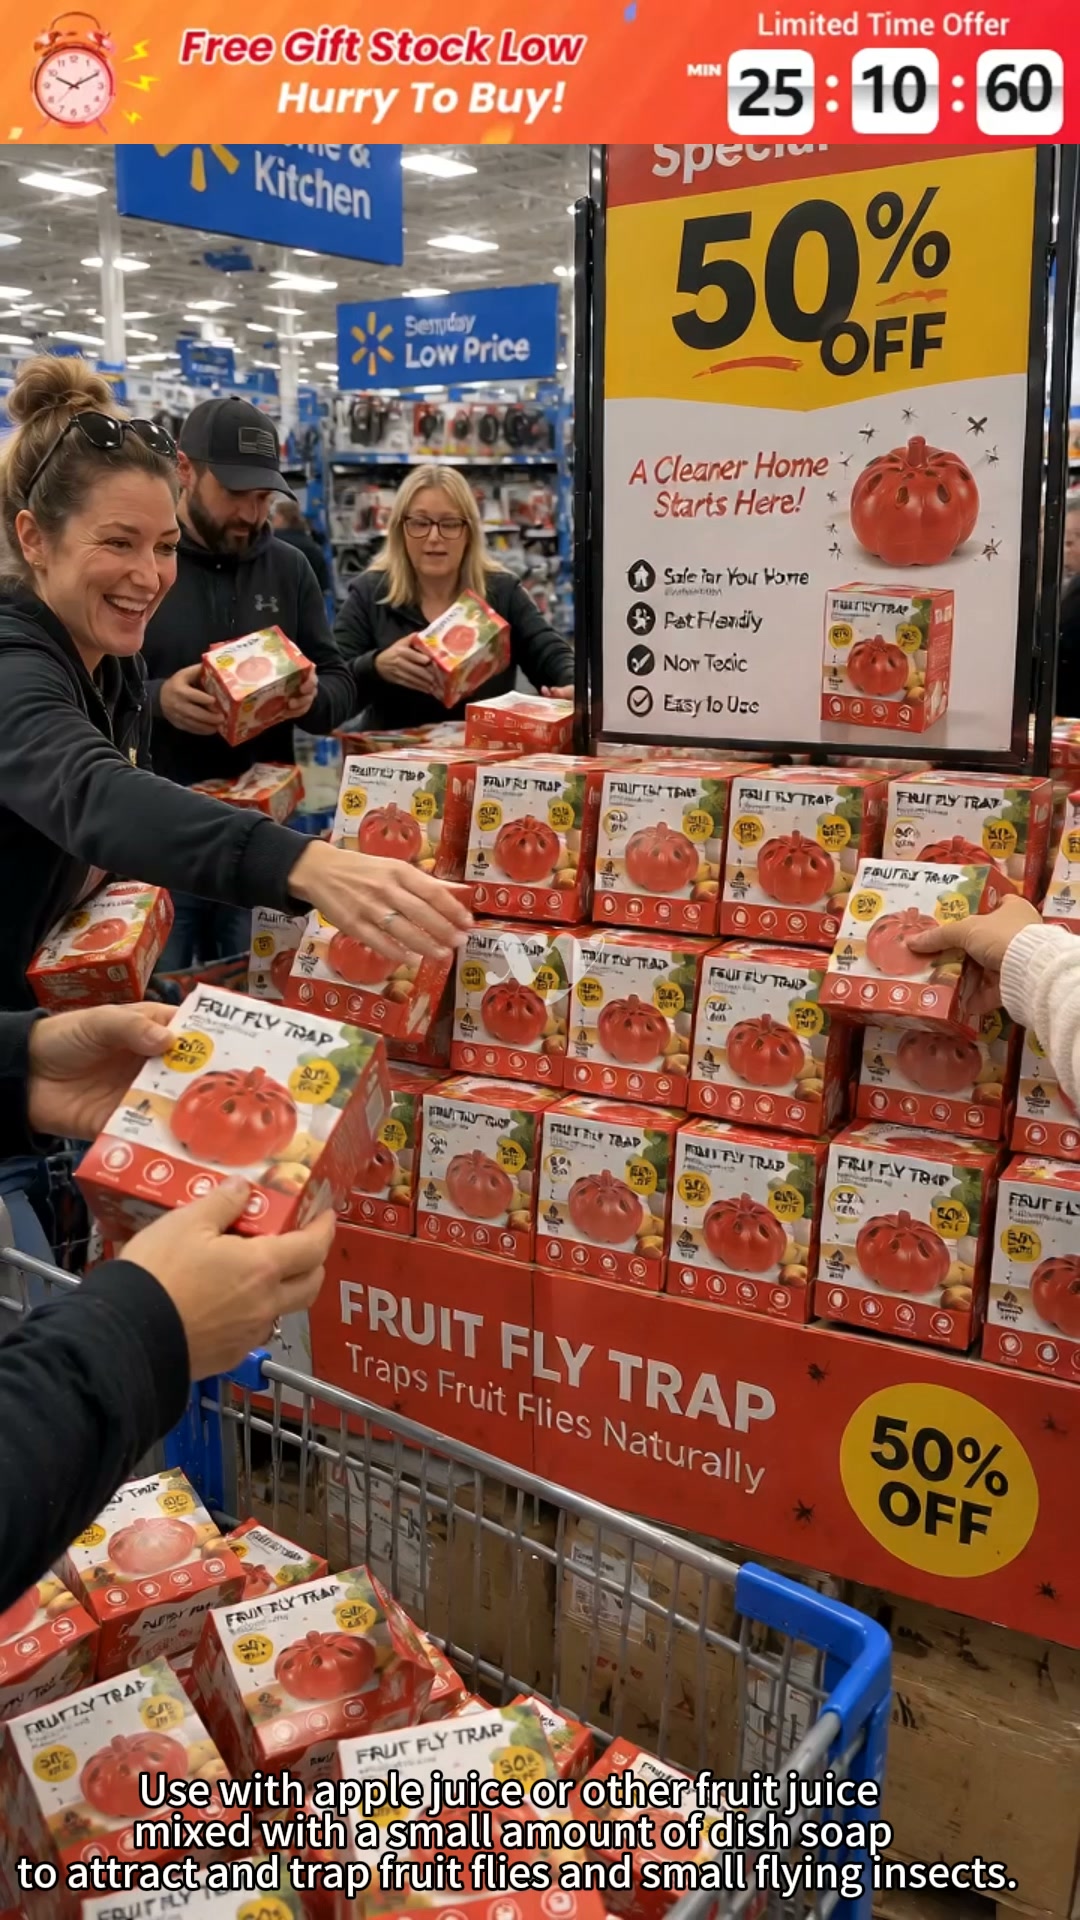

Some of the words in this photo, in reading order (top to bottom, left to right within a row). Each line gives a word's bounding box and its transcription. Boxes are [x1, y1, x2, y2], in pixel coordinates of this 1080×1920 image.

[254, 150, 371, 220] Kitchen
[672, 187, 951, 351] 50%
[405, 343, 459, 369] Low
[463, 333, 531, 363] Price
[820, 312, 947, 376] OFF
[628, 459, 648, 485] A
[653, 454, 749, 485] Cleaner
[754, 451, 829, 480] Home
[653, 491, 728, 518] Starts
[734, 486, 806, 516] Here!
[284, 1020, 334, 1047] TRAP
[340, 1280, 483, 1359] FRUIT
[501, 1321, 595, 1388] FLY
[608, 1348, 776, 1433] TRAP
[345, 1341, 428, 1394] Traps
[438, 1369, 508, 1416] Fruit
[518, 1391, 592, 1439] Flies
[603, 1416, 766, 1494] Naturally
[870, 1415, 1009, 1497] 50%
[878, 1481, 993, 1545] OFF
[416, 1731, 449, 1754] FLY
[452, 1722, 504, 1746] TRAP
